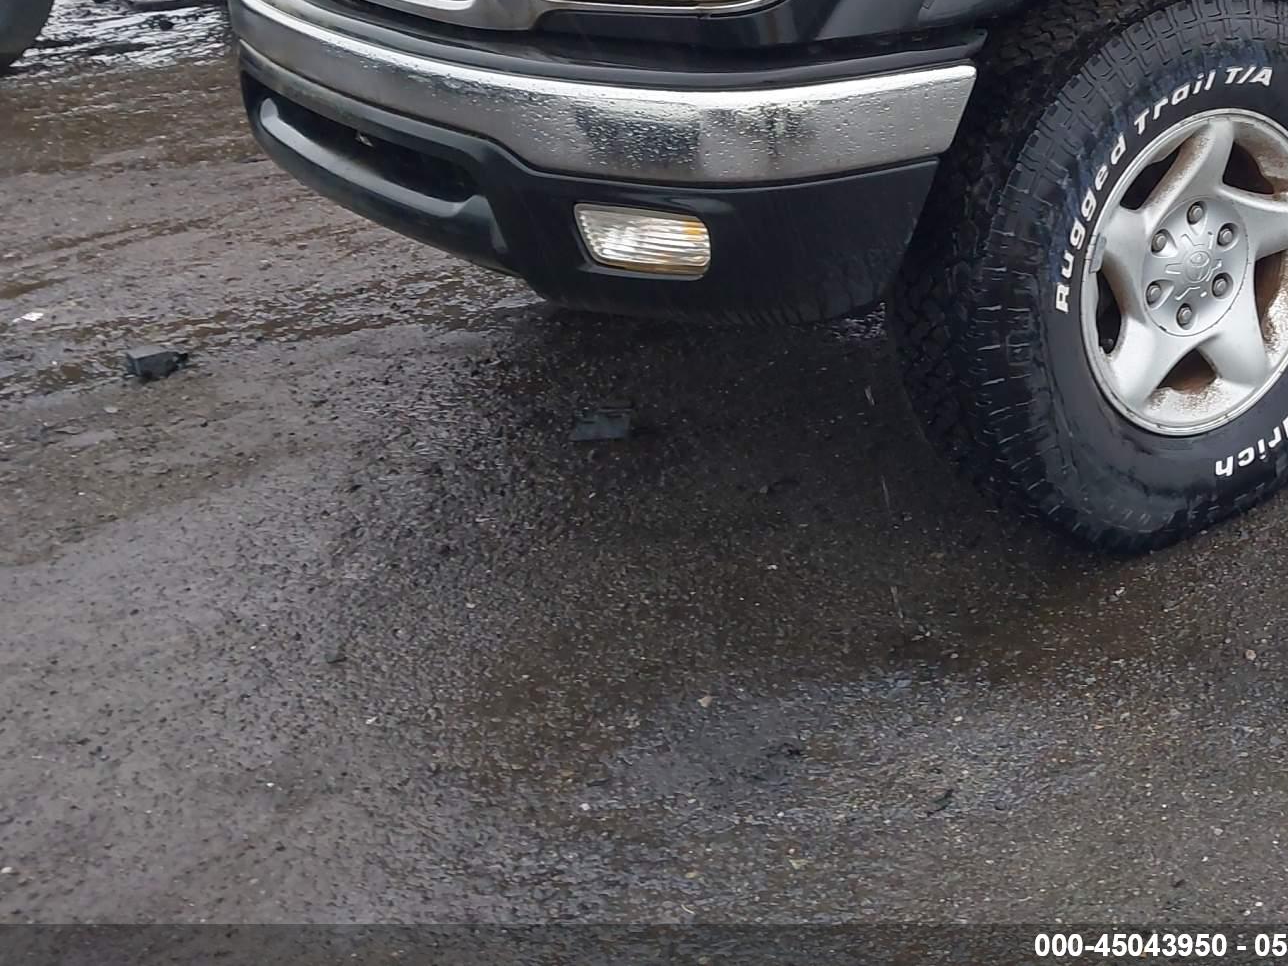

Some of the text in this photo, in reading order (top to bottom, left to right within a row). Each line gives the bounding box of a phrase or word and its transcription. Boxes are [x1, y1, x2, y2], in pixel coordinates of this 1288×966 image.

[1054, 65, 1274, 314] Rugged Trail T/A
